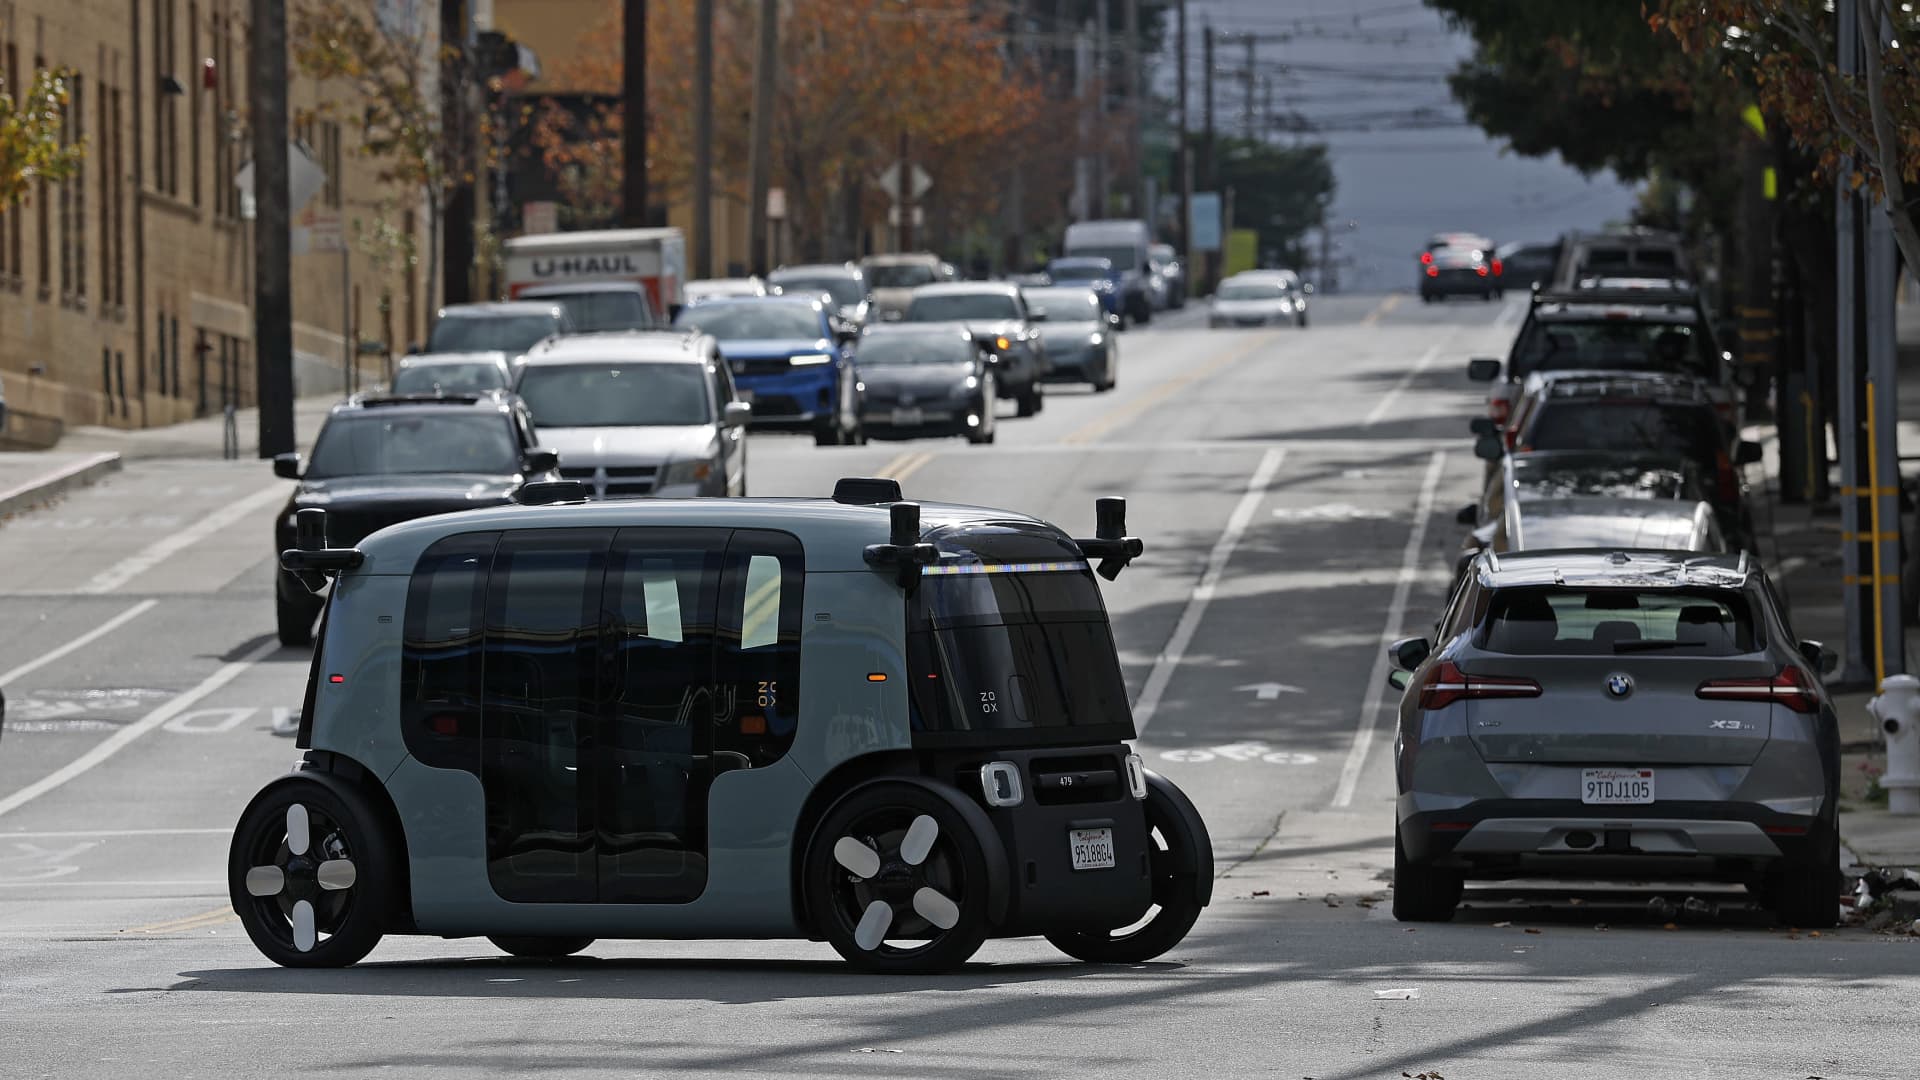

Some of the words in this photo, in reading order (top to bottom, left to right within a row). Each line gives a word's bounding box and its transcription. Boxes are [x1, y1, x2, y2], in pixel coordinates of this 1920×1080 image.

[533, 254, 638, 277] U-HAUL
[980, 691, 996, 702] ZO
[982, 702, 998, 713] OX
[1709, 720, 1741, 729] X3
[1060, 776, 1073, 786] 479
[1587, 781, 1650, 799] 9TDJ105
[1075, 843, 1112, 864] 95188G4
